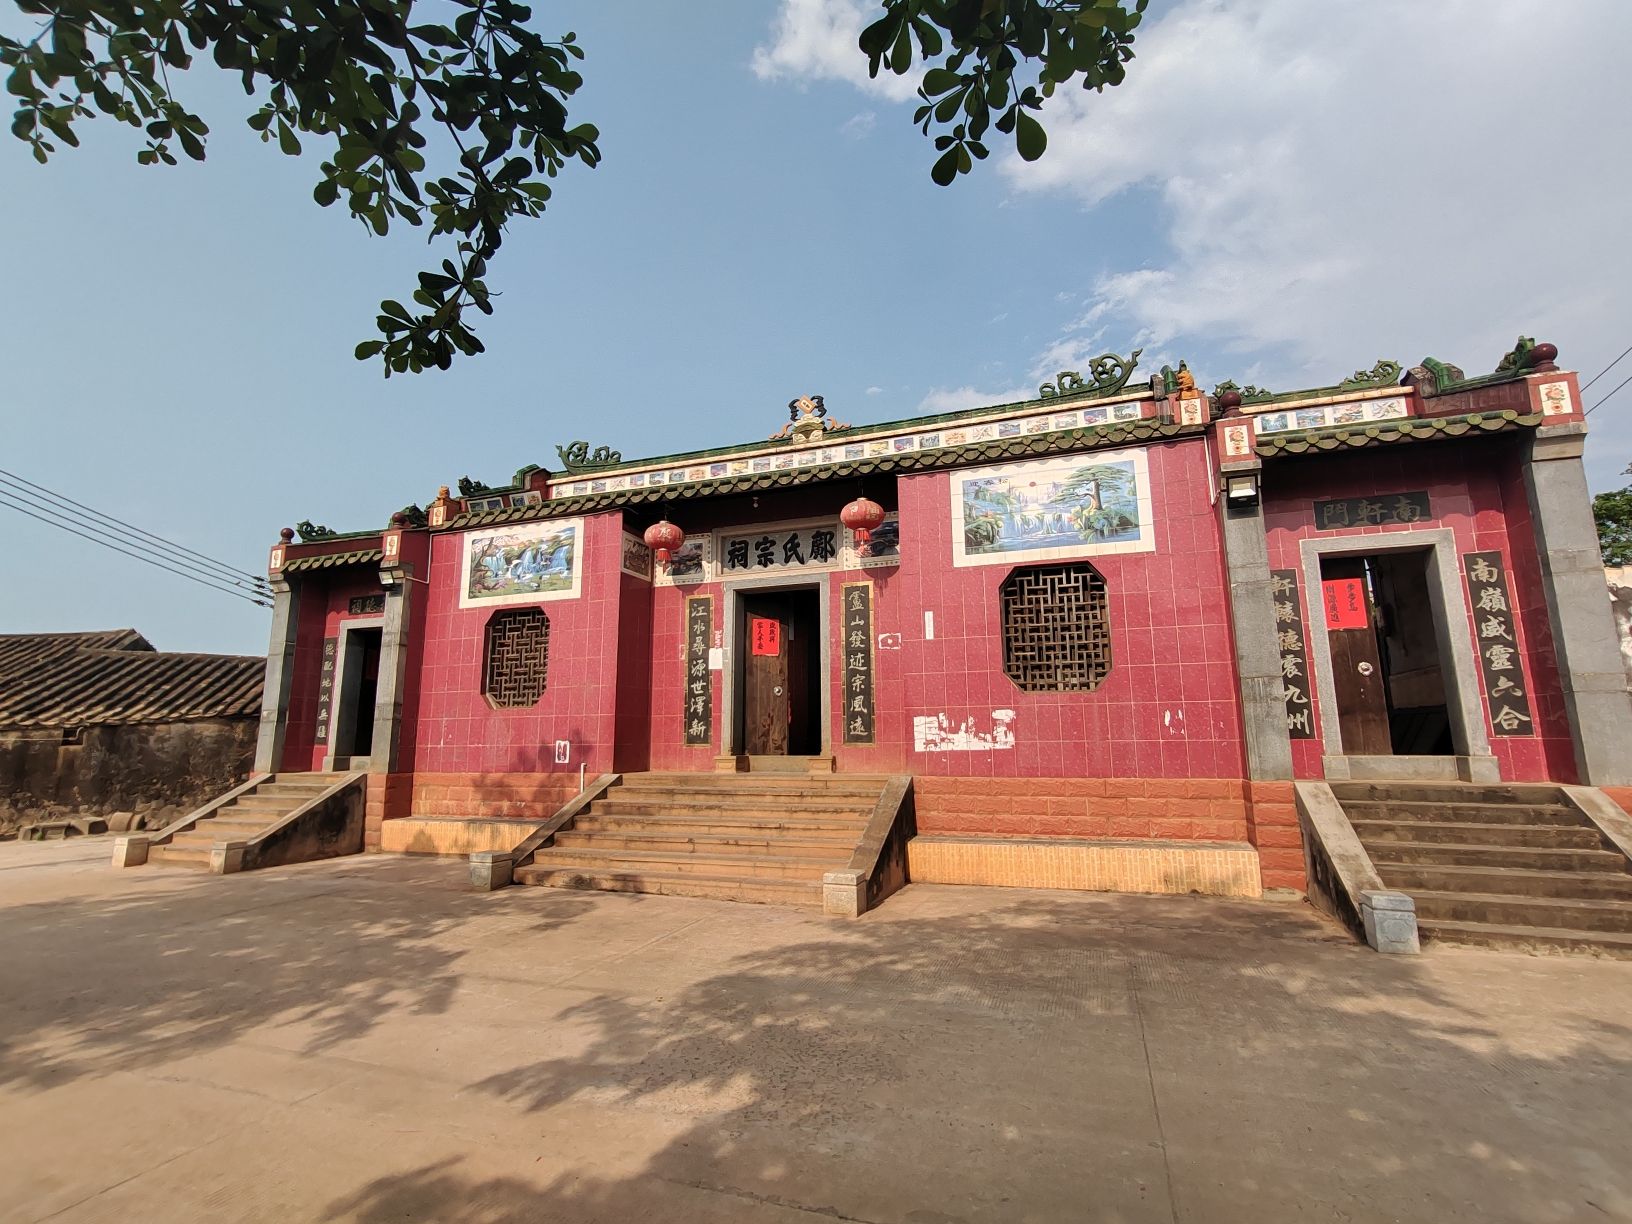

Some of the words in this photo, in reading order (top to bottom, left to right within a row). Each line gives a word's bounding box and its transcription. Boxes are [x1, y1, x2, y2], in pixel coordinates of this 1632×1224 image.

[1323, 496, 1421, 526] 南軒門
[727, 529, 836, 570] 鄺氏宗祠
[1470, 557, 1531, 731] 南嶺威靈六合
